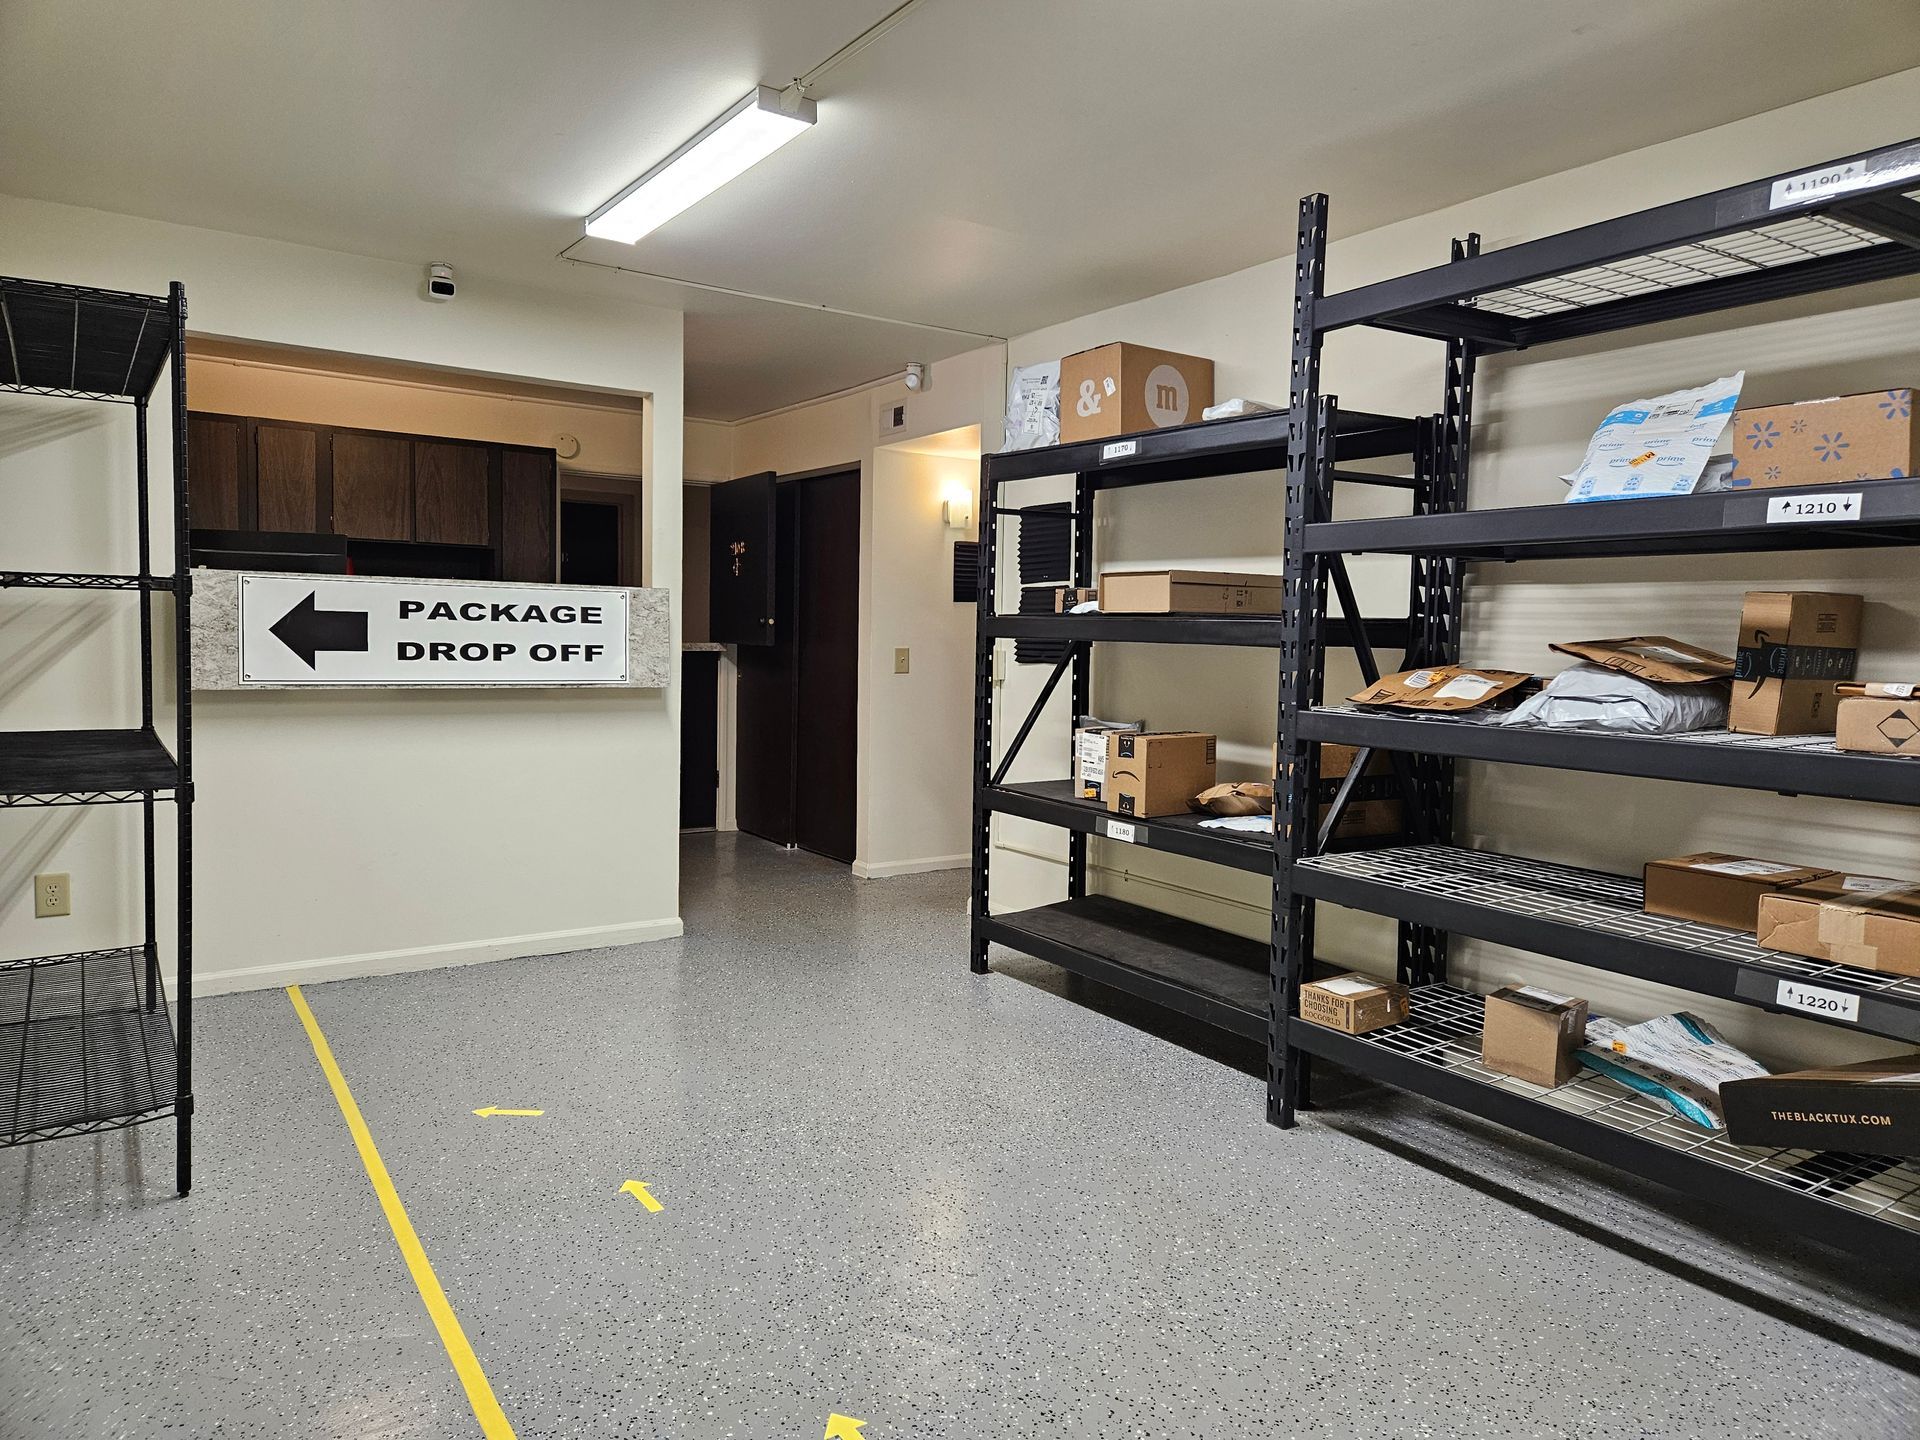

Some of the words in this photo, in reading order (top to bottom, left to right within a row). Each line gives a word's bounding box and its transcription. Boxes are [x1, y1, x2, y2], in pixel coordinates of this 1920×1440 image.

[1800, 173, 1841, 190] 1190
[1156, 384, 1178, 412] m
[1795, 502, 1837, 515] 1210
[399, 600, 603, 625] PACKAGE
[397, 641, 517, 662] DROP
[529, 643, 605, 663] OFF
[1777, 647, 1788, 674] prime
[1735, 651, 1745, 678] prime
[1115, 826, 1130, 837] 1180
[1304, 989, 1330, 1005] THANKS
[1331, 996, 1345, 1009] FOR
[1304, 999, 1338, 1017] CHOOSING
[1797, 993, 1839, 1012] 1220
[1771, 1111, 1891, 1126] THEBLACKTUX.COM
